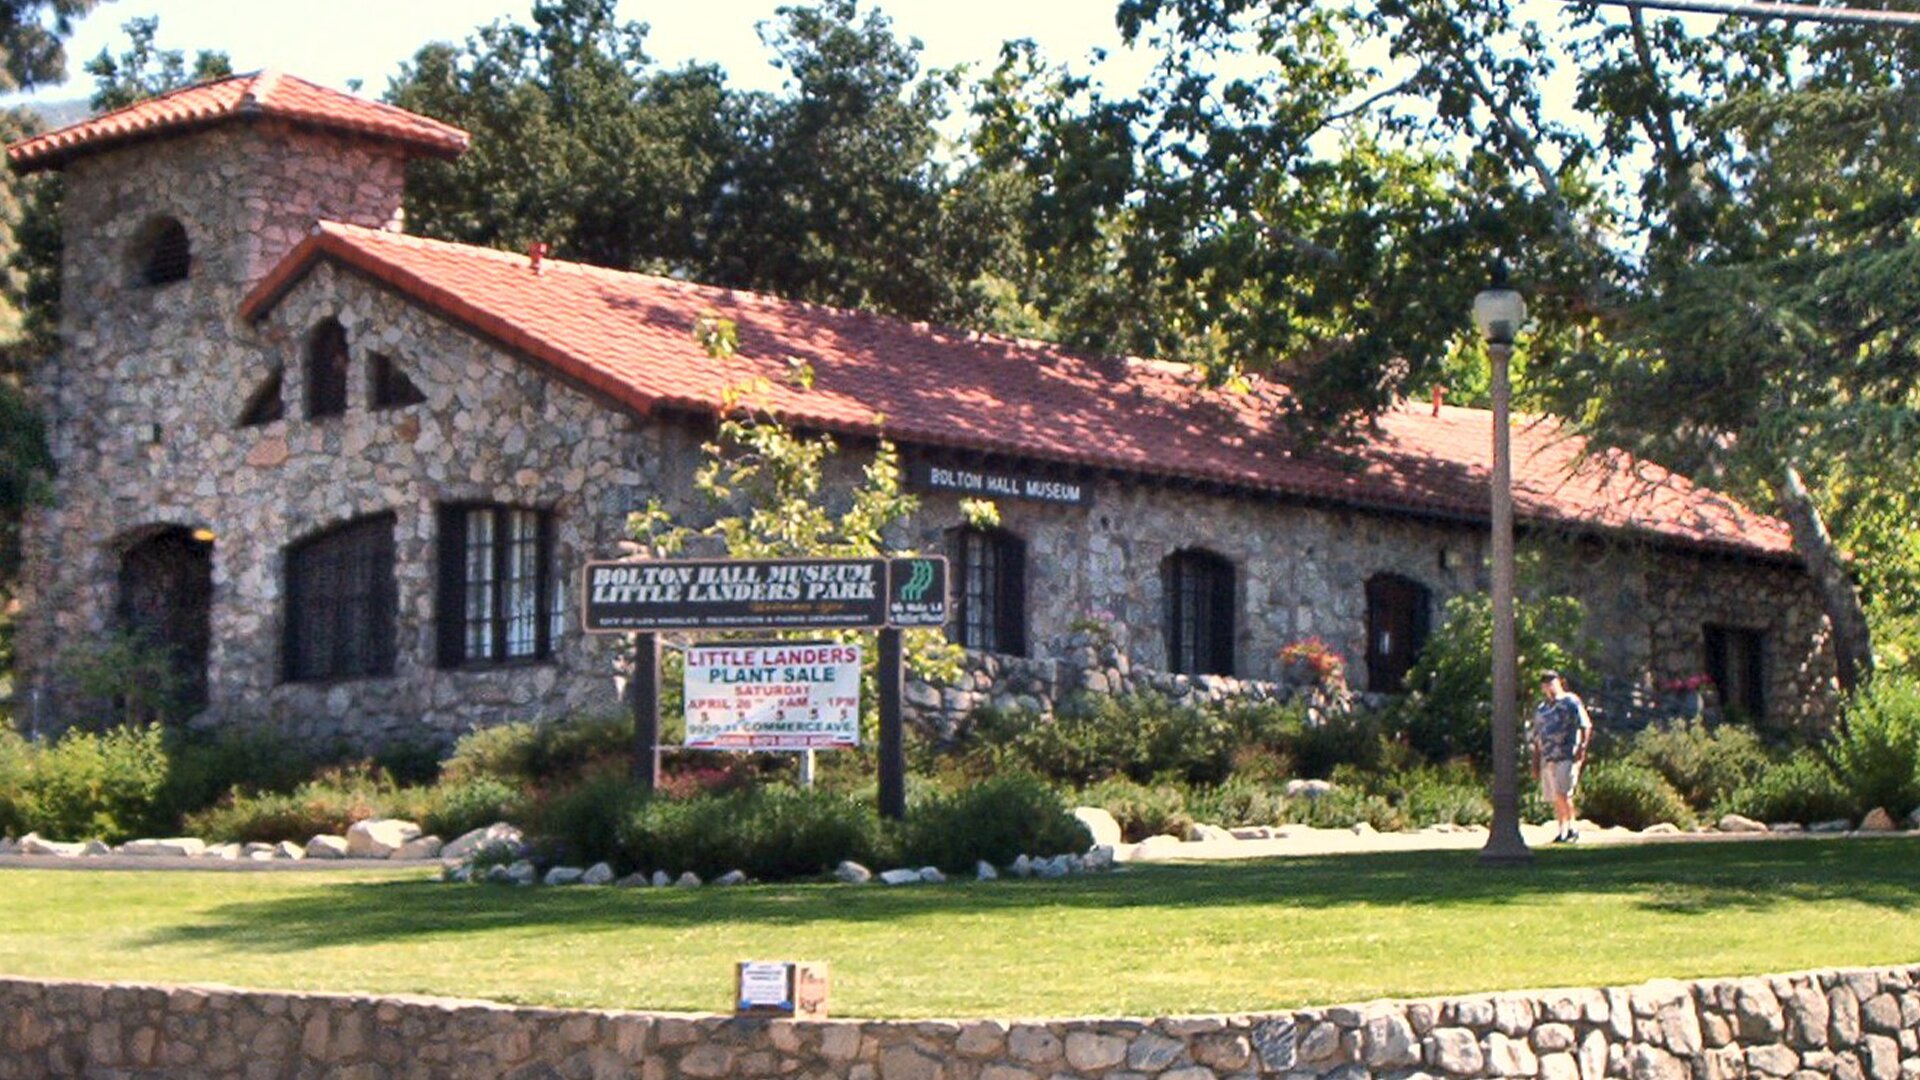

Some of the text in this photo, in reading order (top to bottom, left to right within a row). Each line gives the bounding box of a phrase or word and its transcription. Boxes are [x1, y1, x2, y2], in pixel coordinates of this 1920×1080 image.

[930, 467, 1081, 501] BOLTON HALL MUSEUM
[592, 563, 874, 586] BOLTON HALL MUSEUM
[591, 580, 877, 603] LITTLE LANDERS PARK
[687, 647, 857, 667] LITTLE LANDERS
[708, 666, 836, 684] PLANT SALE
[734, 685, 810, 697] SATURDAY
[688, 699, 730, 710] APRIL
[743, 721, 821, 733] COMMERCE
